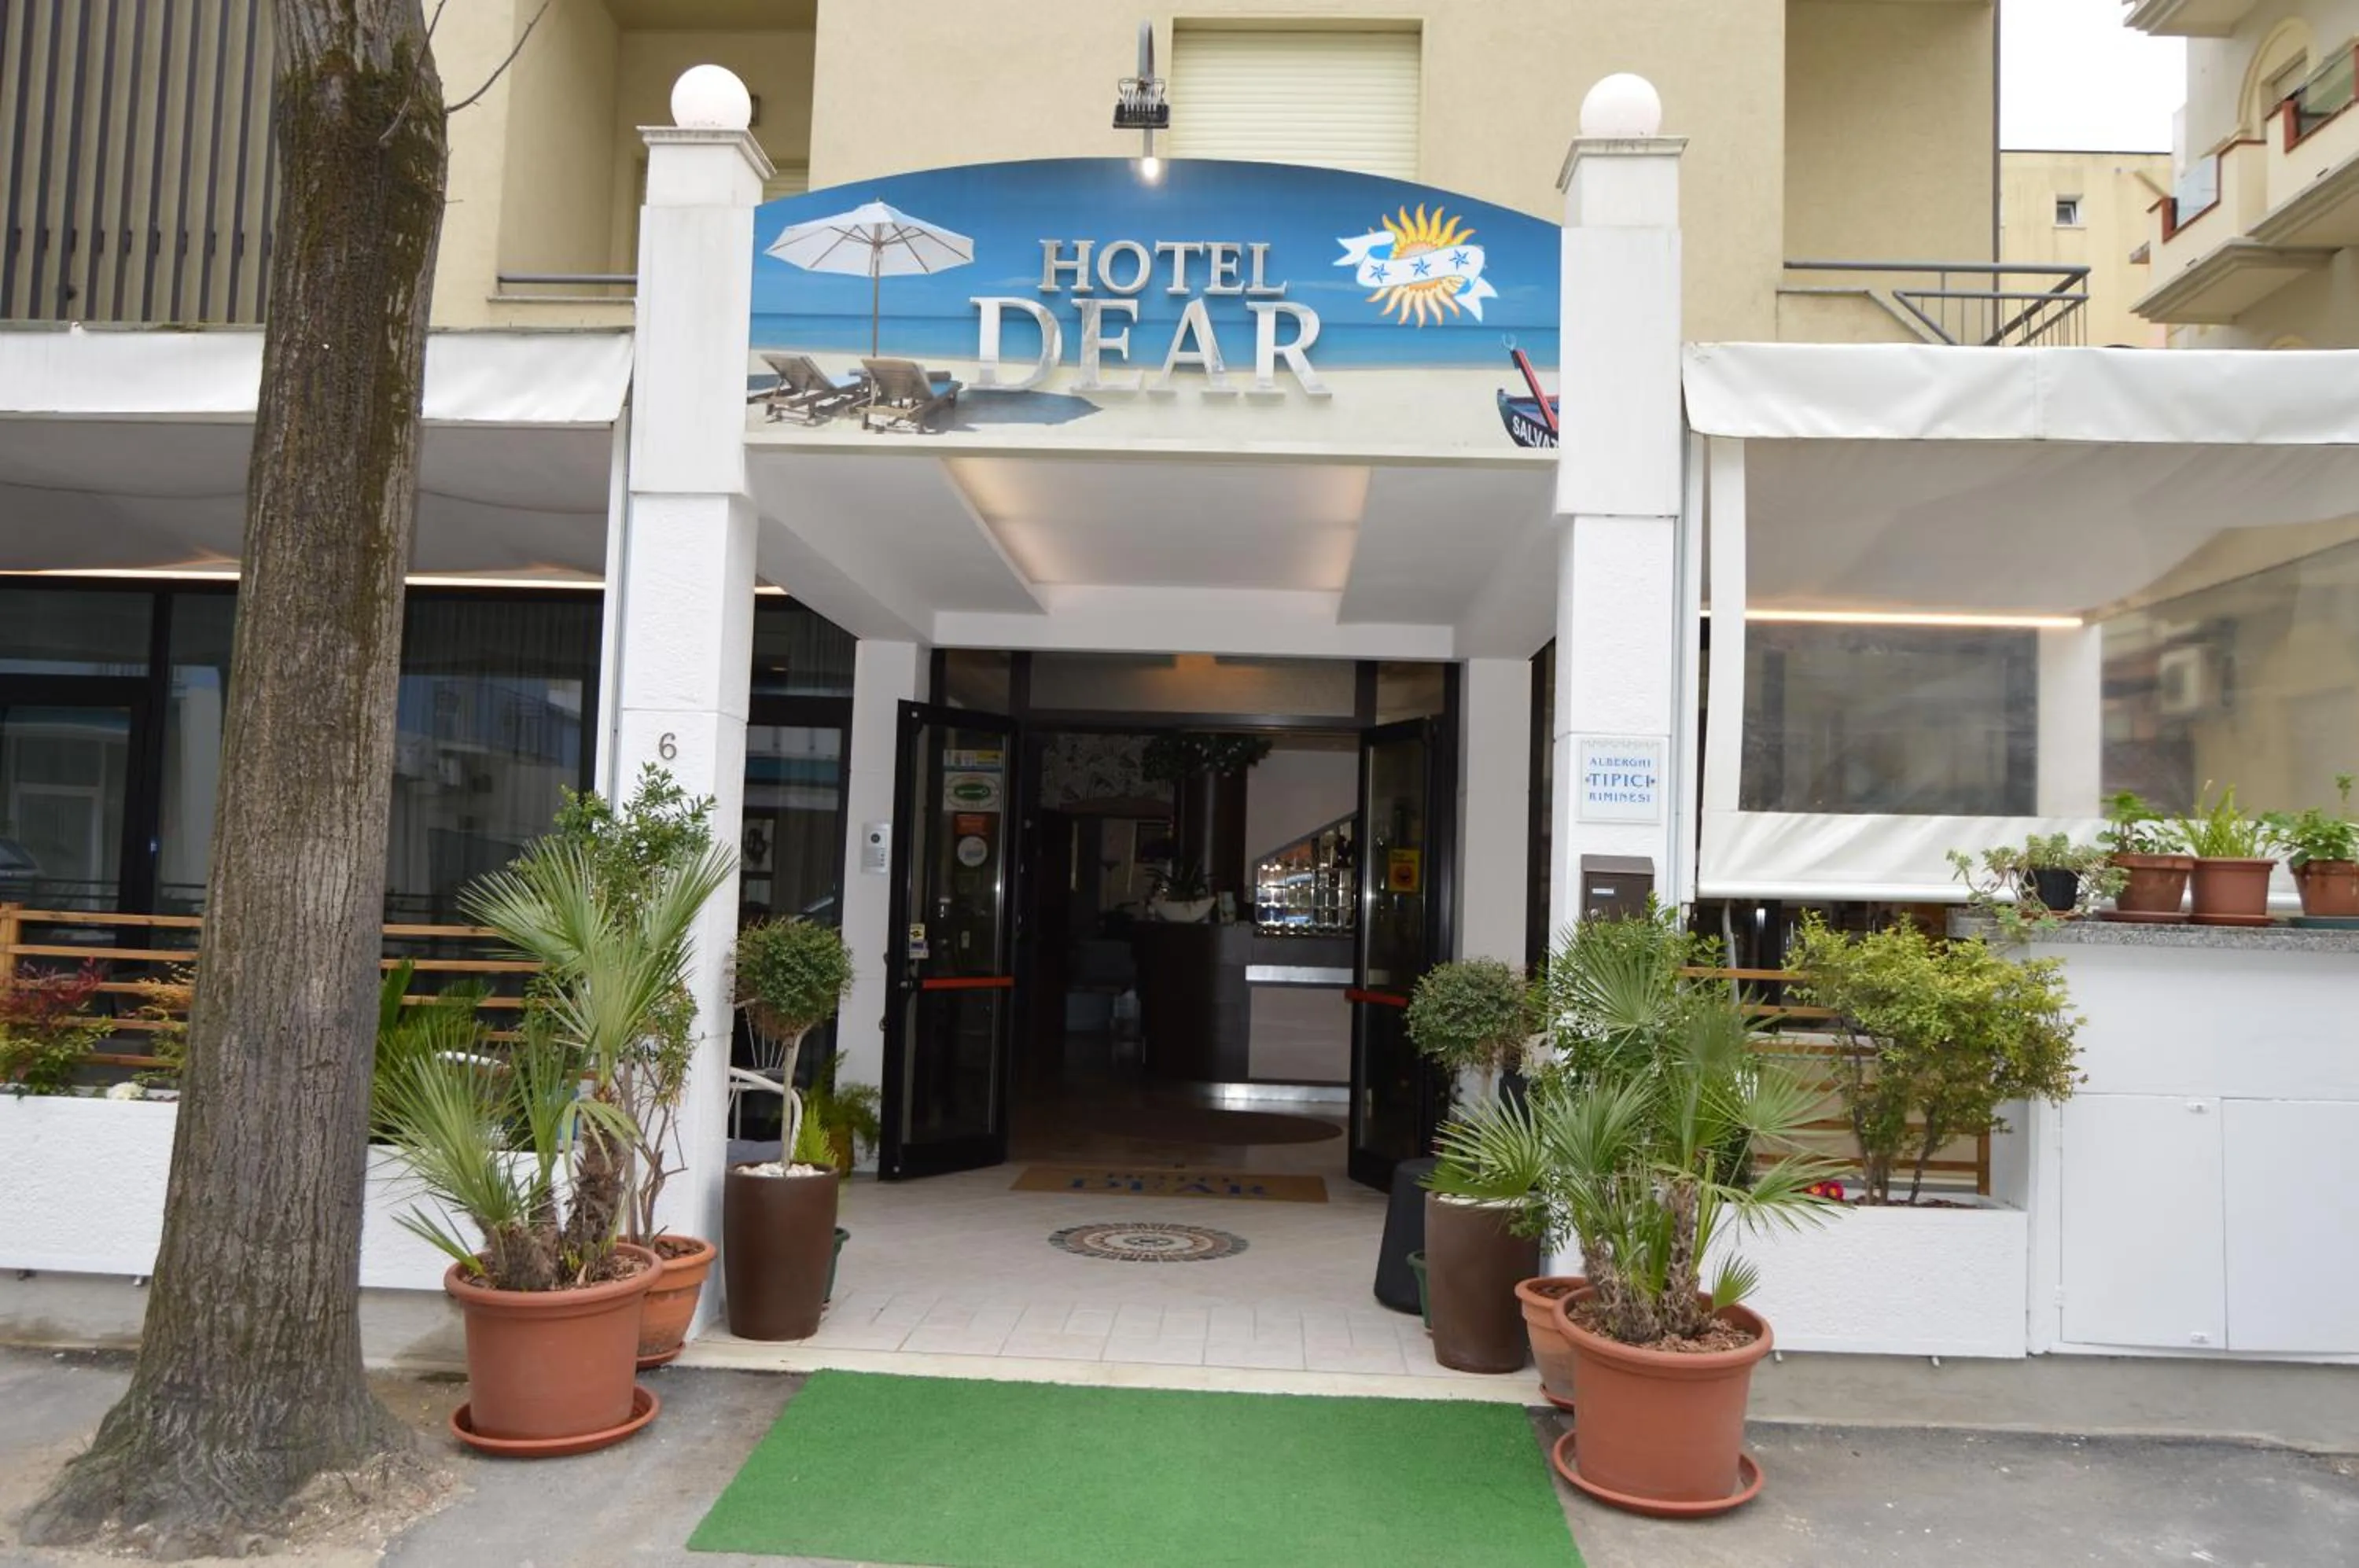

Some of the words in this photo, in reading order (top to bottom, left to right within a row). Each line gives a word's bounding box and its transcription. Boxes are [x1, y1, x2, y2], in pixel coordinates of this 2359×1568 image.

[1037, 238, 1287, 295] HOTEL
[969, 296, 1334, 399] DEAR
[658, 731, 677, 760] 6
[1590, 757, 1651, 767] ALBERGHI
[1589, 773, 1650, 788] TIPICI
[1589, 792, 1651, 803] RIMINESI
